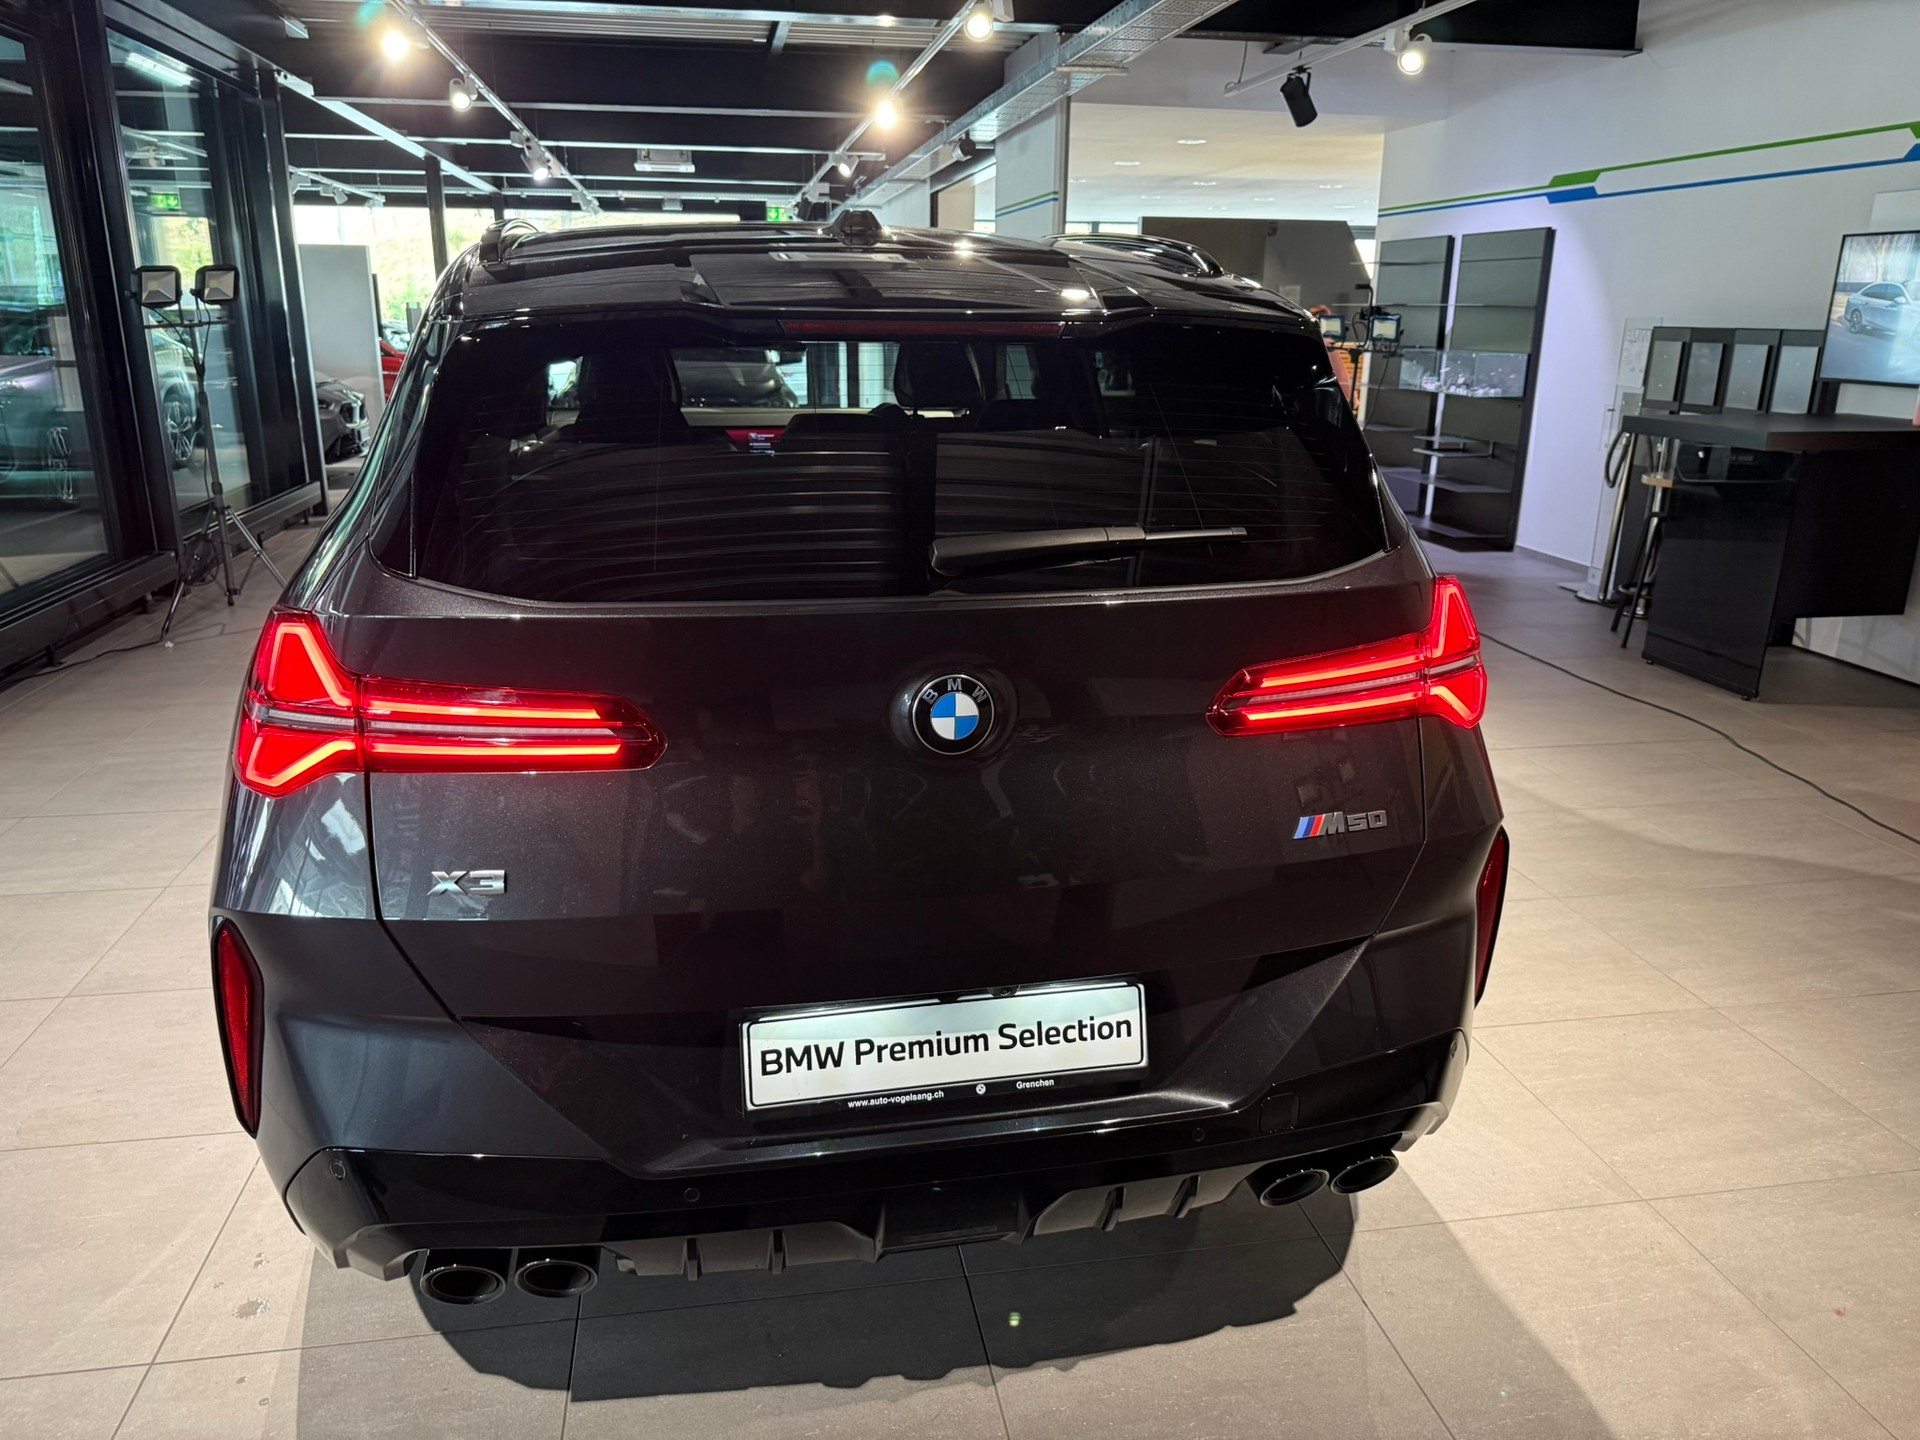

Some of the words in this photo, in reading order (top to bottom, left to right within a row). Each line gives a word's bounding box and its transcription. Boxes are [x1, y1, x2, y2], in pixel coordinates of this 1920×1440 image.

[922, 678, 987, 704] BMW
[1317, 810, 1388, 836] M50
[427, 869, 506, 895] X3
[760, 1041, 845, 1077] BMW
[855, 1030, 990, 1066] Premium
[998, 1015, 1133, 1050] Selection
[847, 1089, 945, 1109] www.auto-vogelsang.ch
[1015, 1079, 1055, 1090] Grenchen
